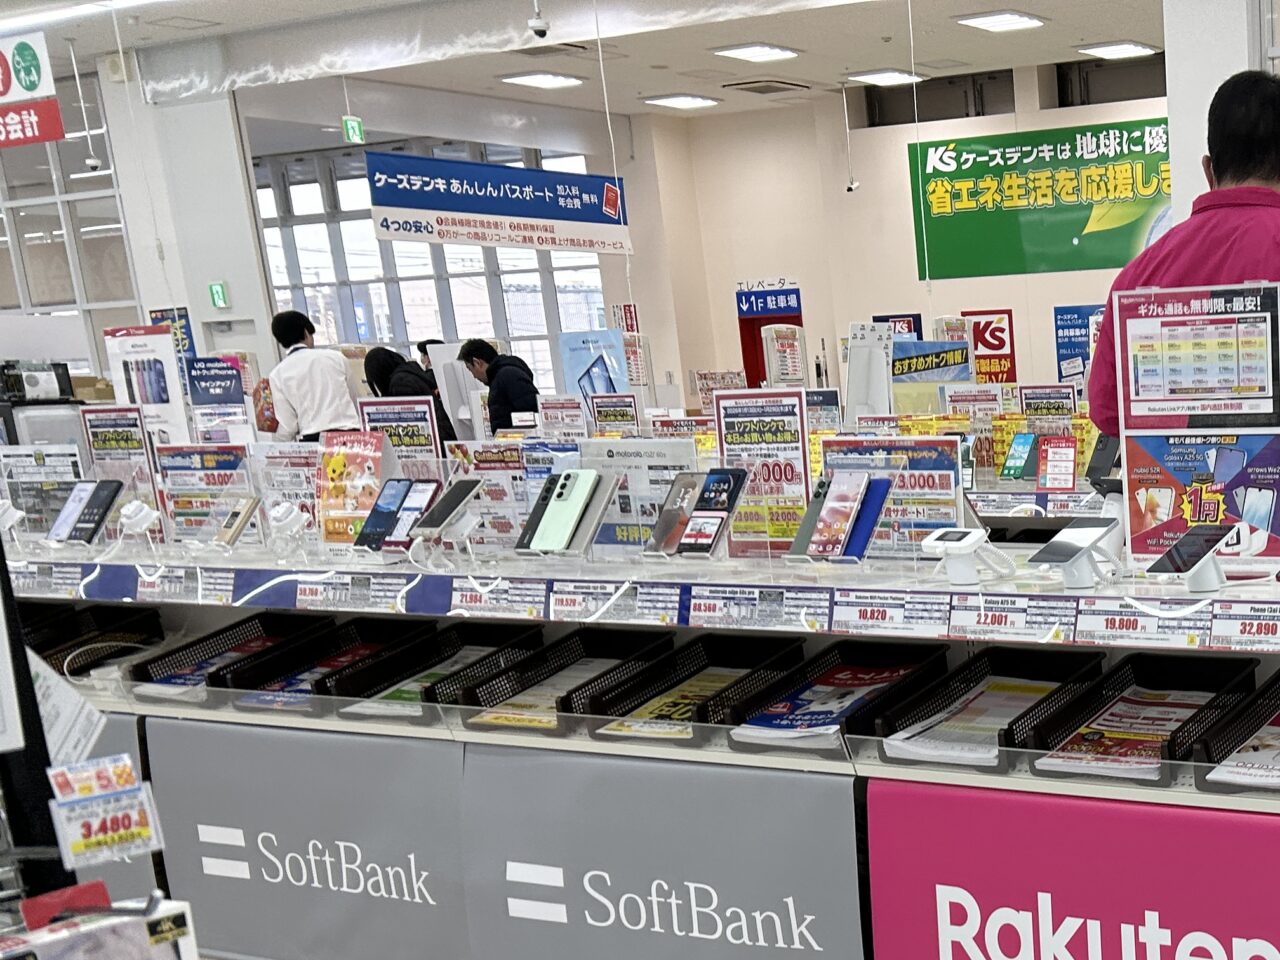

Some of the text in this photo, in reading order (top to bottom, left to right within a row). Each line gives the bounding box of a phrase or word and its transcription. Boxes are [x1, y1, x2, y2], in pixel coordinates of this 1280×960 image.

[380, 217, 433, 234] 4つの安心
[737, 278, 797, 291] エレベーター
[750, 294, 797, 311] 1F 駐車場
[894, 349, 967, 375] おすすめオトク情報!
[736, 420, 786, 431] ソフトバンクで
[1187, 486, 1219, 522] 1円
[858, 608, 887, 621] 10,820
[976, 612, 1009, 626] 22,001
[1104, 616, 1139, 631] 19,800
[1240, 622, 1278, 636] 32,890
[81, 814, 132, 840] 3,480
[256, 832, 437, 905] SoftBank
[582, 870, 824, 951] SoftBank
